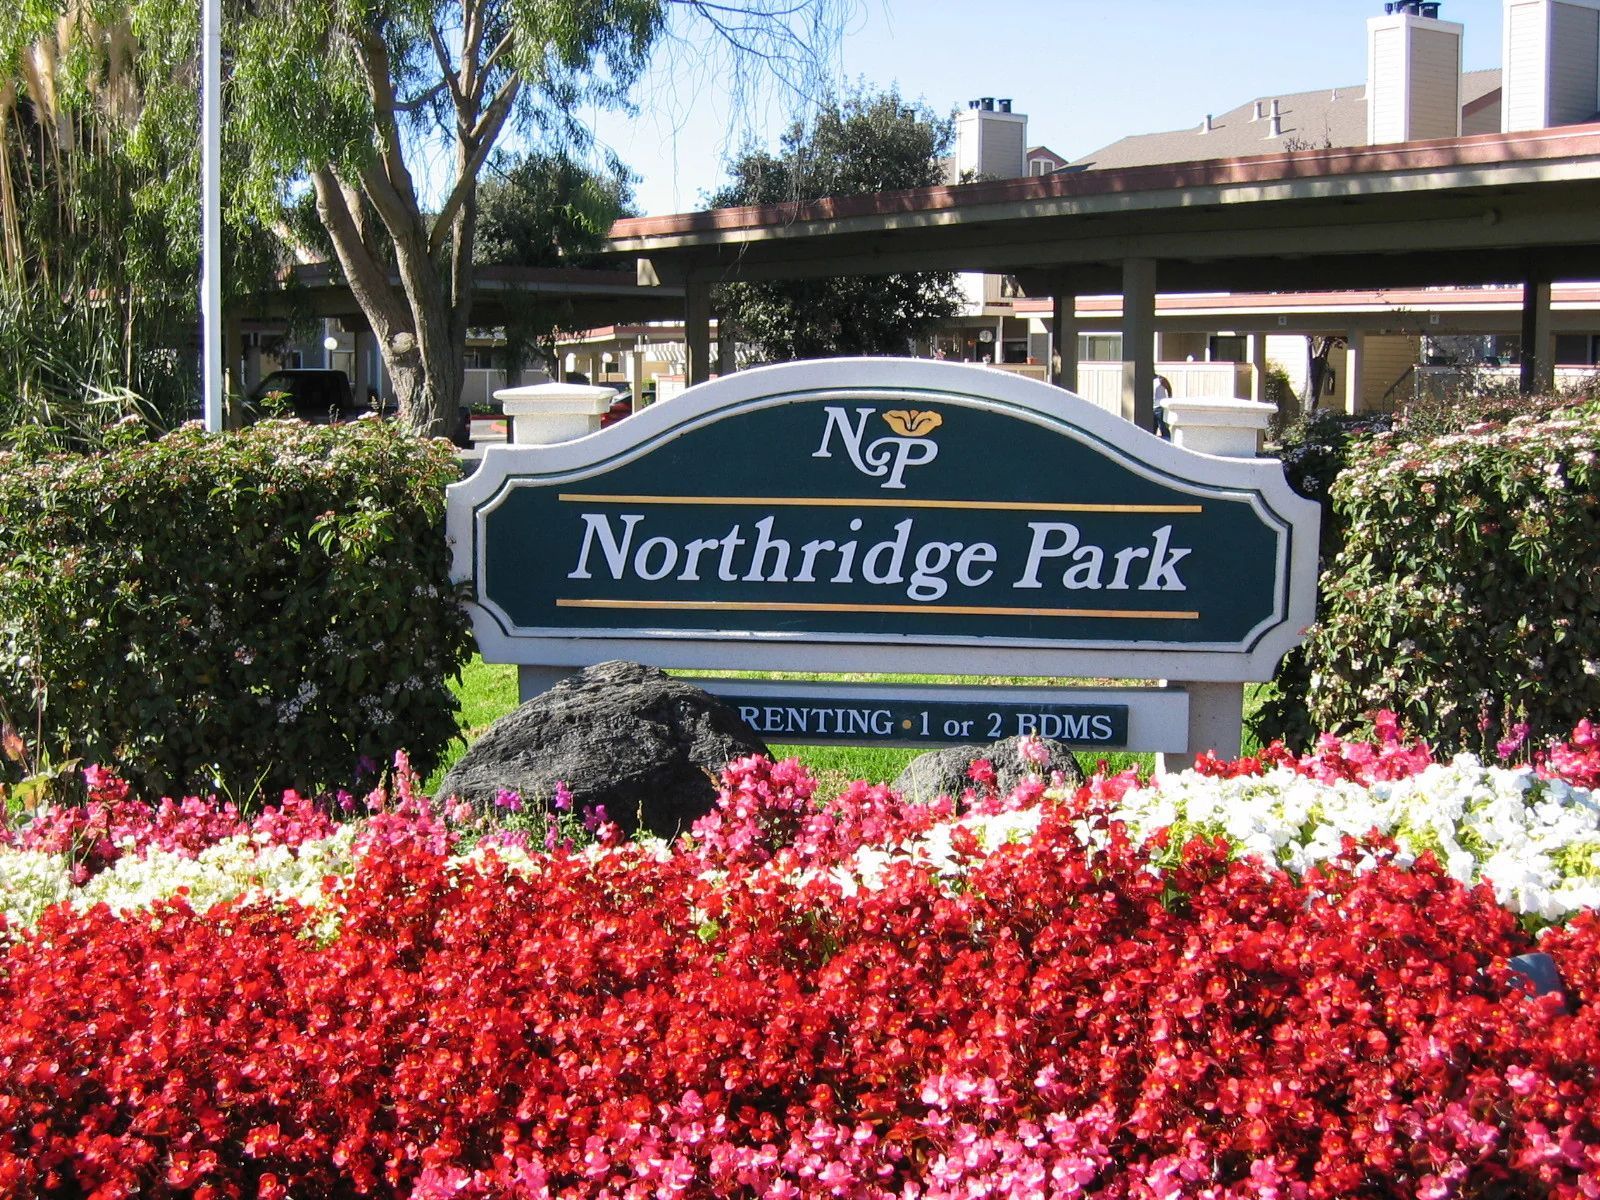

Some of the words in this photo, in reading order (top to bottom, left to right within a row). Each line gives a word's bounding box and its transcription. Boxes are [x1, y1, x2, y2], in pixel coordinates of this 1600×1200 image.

[567, 513, 998, 602] Northridge
[1012, 522, 1192, 592] Park
[737, 706, 894, 735] RENTING
[919, 711, 931, 736] 1
[943, 719, 974, 737] or
[987, 712, 1003, 738] 2
[1015, 713, 1114, 740] BDMS
